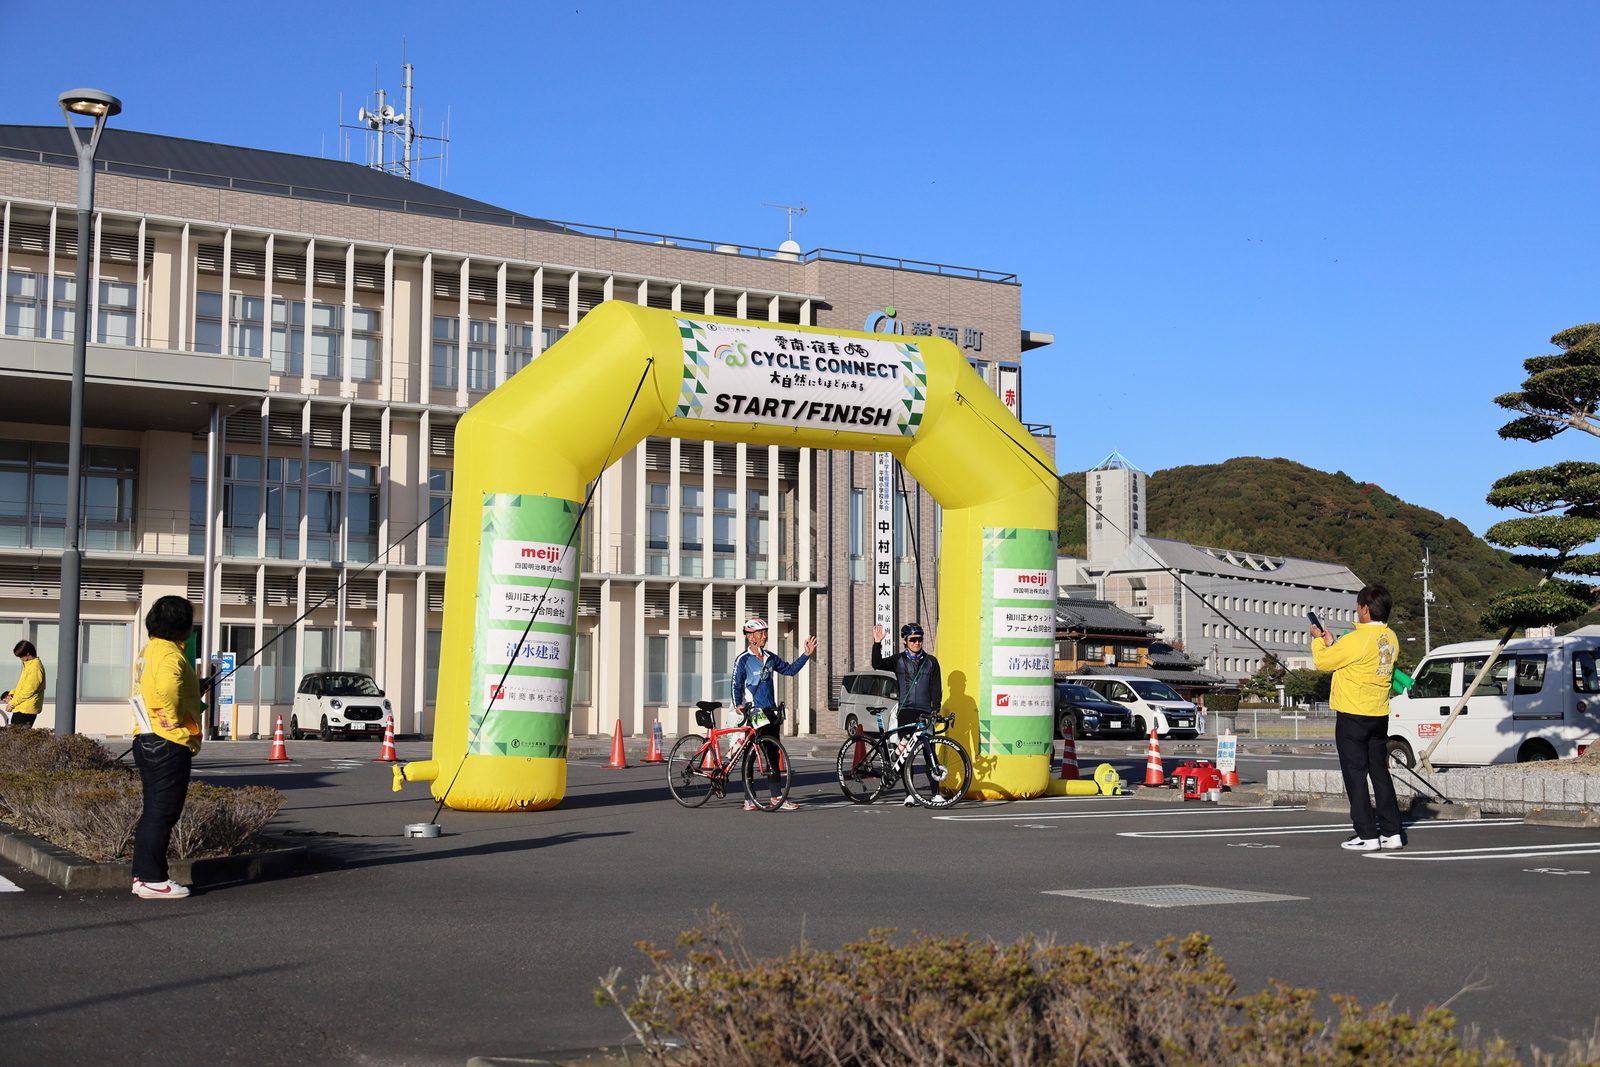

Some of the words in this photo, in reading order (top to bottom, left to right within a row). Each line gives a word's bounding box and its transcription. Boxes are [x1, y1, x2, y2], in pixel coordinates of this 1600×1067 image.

[775, 335, 840, 355] 愛南・宿毛
[911, 320, 984, 352] 愛南町
[751, 351, 811, 371] CYCLE
[815, 357, 899, 379] CONNECT
[770, 371, 864, 392] 大自然にもほどがある
[1005, 389, 1016, 407] 赤
[714, 393, 892, 427] START/FINISH
[521, 546, 559, 563] meiji
[878, 520, 891, 597] 中村哲太
[514, 562, 563, 573] 四国明治株式会社
[1018, 572, 1047, 587] meiji
[505, 605, 565, 618] ファーム合同会社
[506, 642, 560, 661] 清水建設
[1008, 657, 1050, 671] 清水建設
